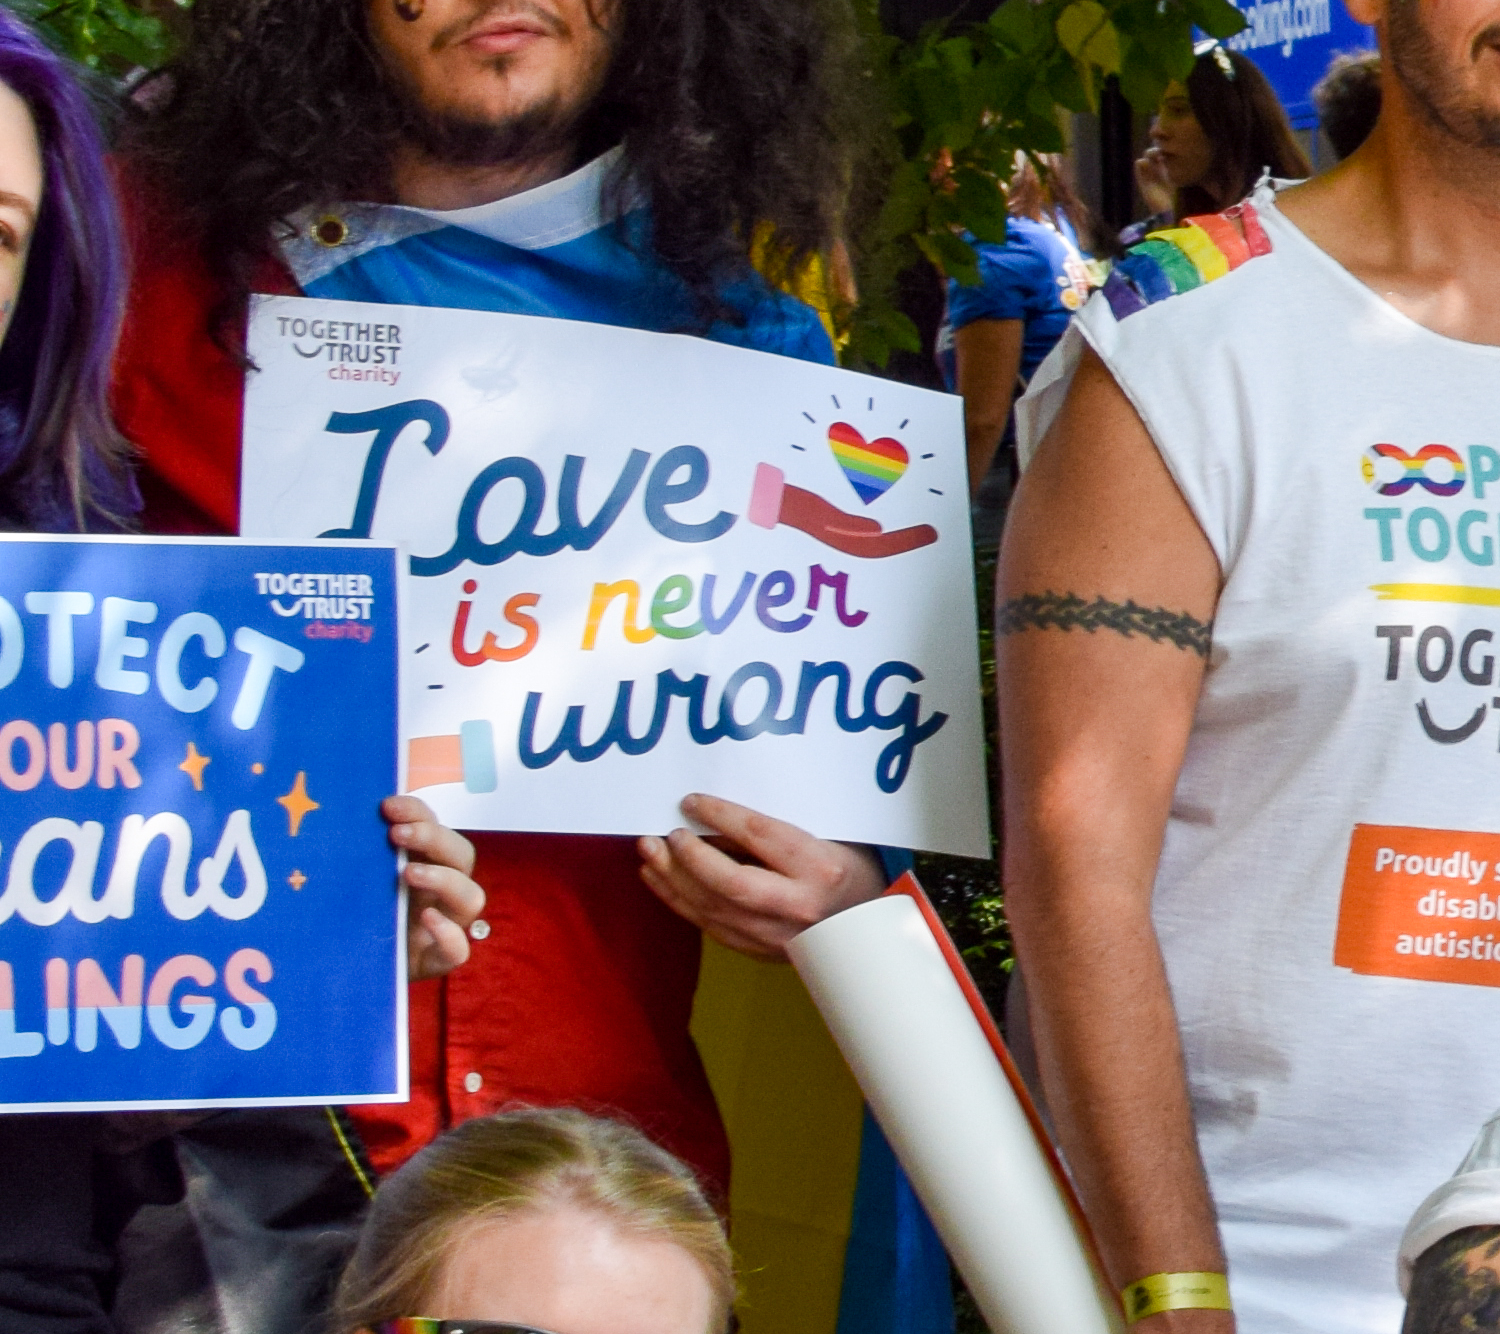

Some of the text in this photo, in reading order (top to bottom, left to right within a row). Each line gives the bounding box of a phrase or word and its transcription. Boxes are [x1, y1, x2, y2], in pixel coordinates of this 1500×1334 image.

[277, 316, 401, 344] TOGETHER
[324, 342, 401, 366] TRUST
[328, 364, 401, 386] charity
[314, 398, 736, 578] Love
[254, 572, 374, 598] TOGETHER
[303, 597, 374, 620] TRUST
[451, 561, 869, 667] is never
[304, 622, 375, 643] charity
[518, 659, 951, 795] wrong
[1376, 847, 1488, 884] Proudly
